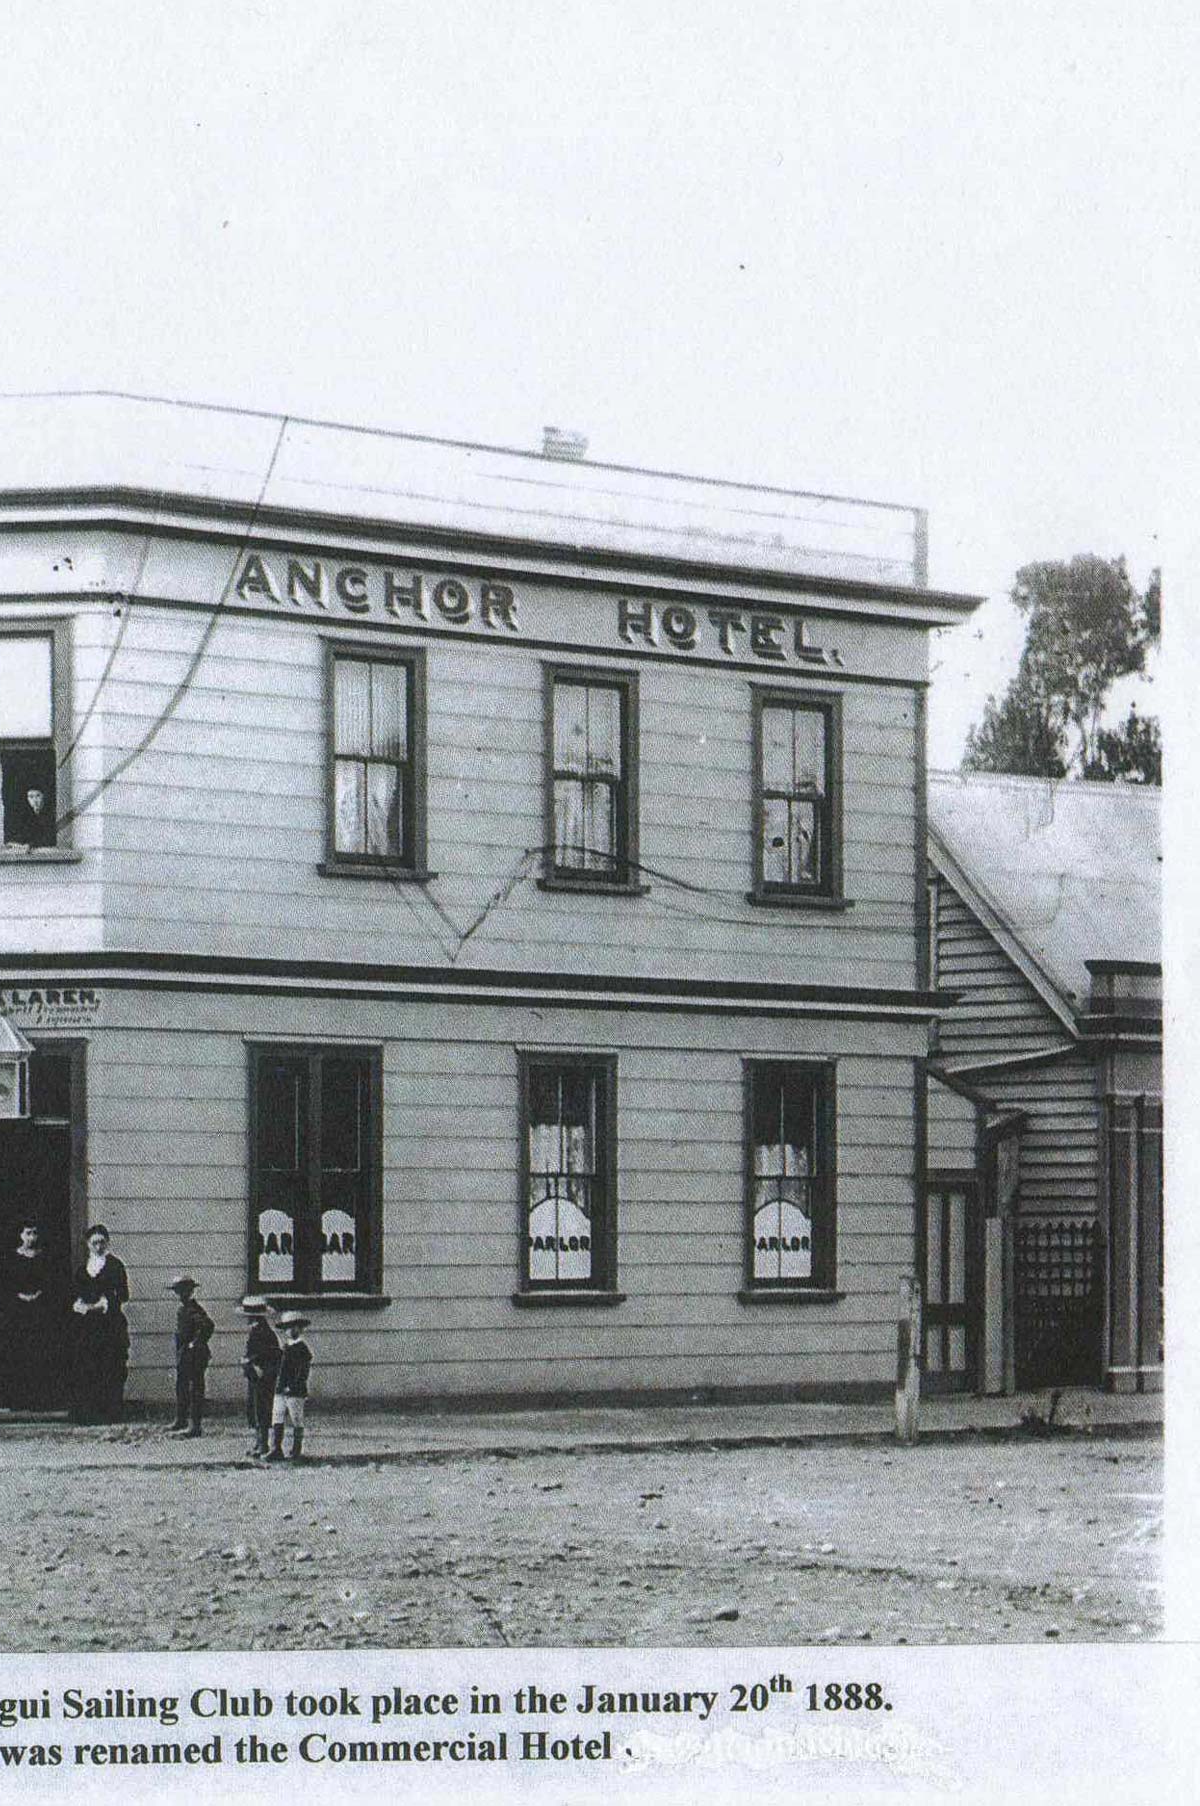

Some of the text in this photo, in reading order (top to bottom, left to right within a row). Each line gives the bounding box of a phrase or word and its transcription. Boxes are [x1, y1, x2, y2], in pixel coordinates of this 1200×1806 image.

[236, 554, 844, 666] ANCHOR HOTEL.
[753, 1236, 810, 1252] ARLOR
